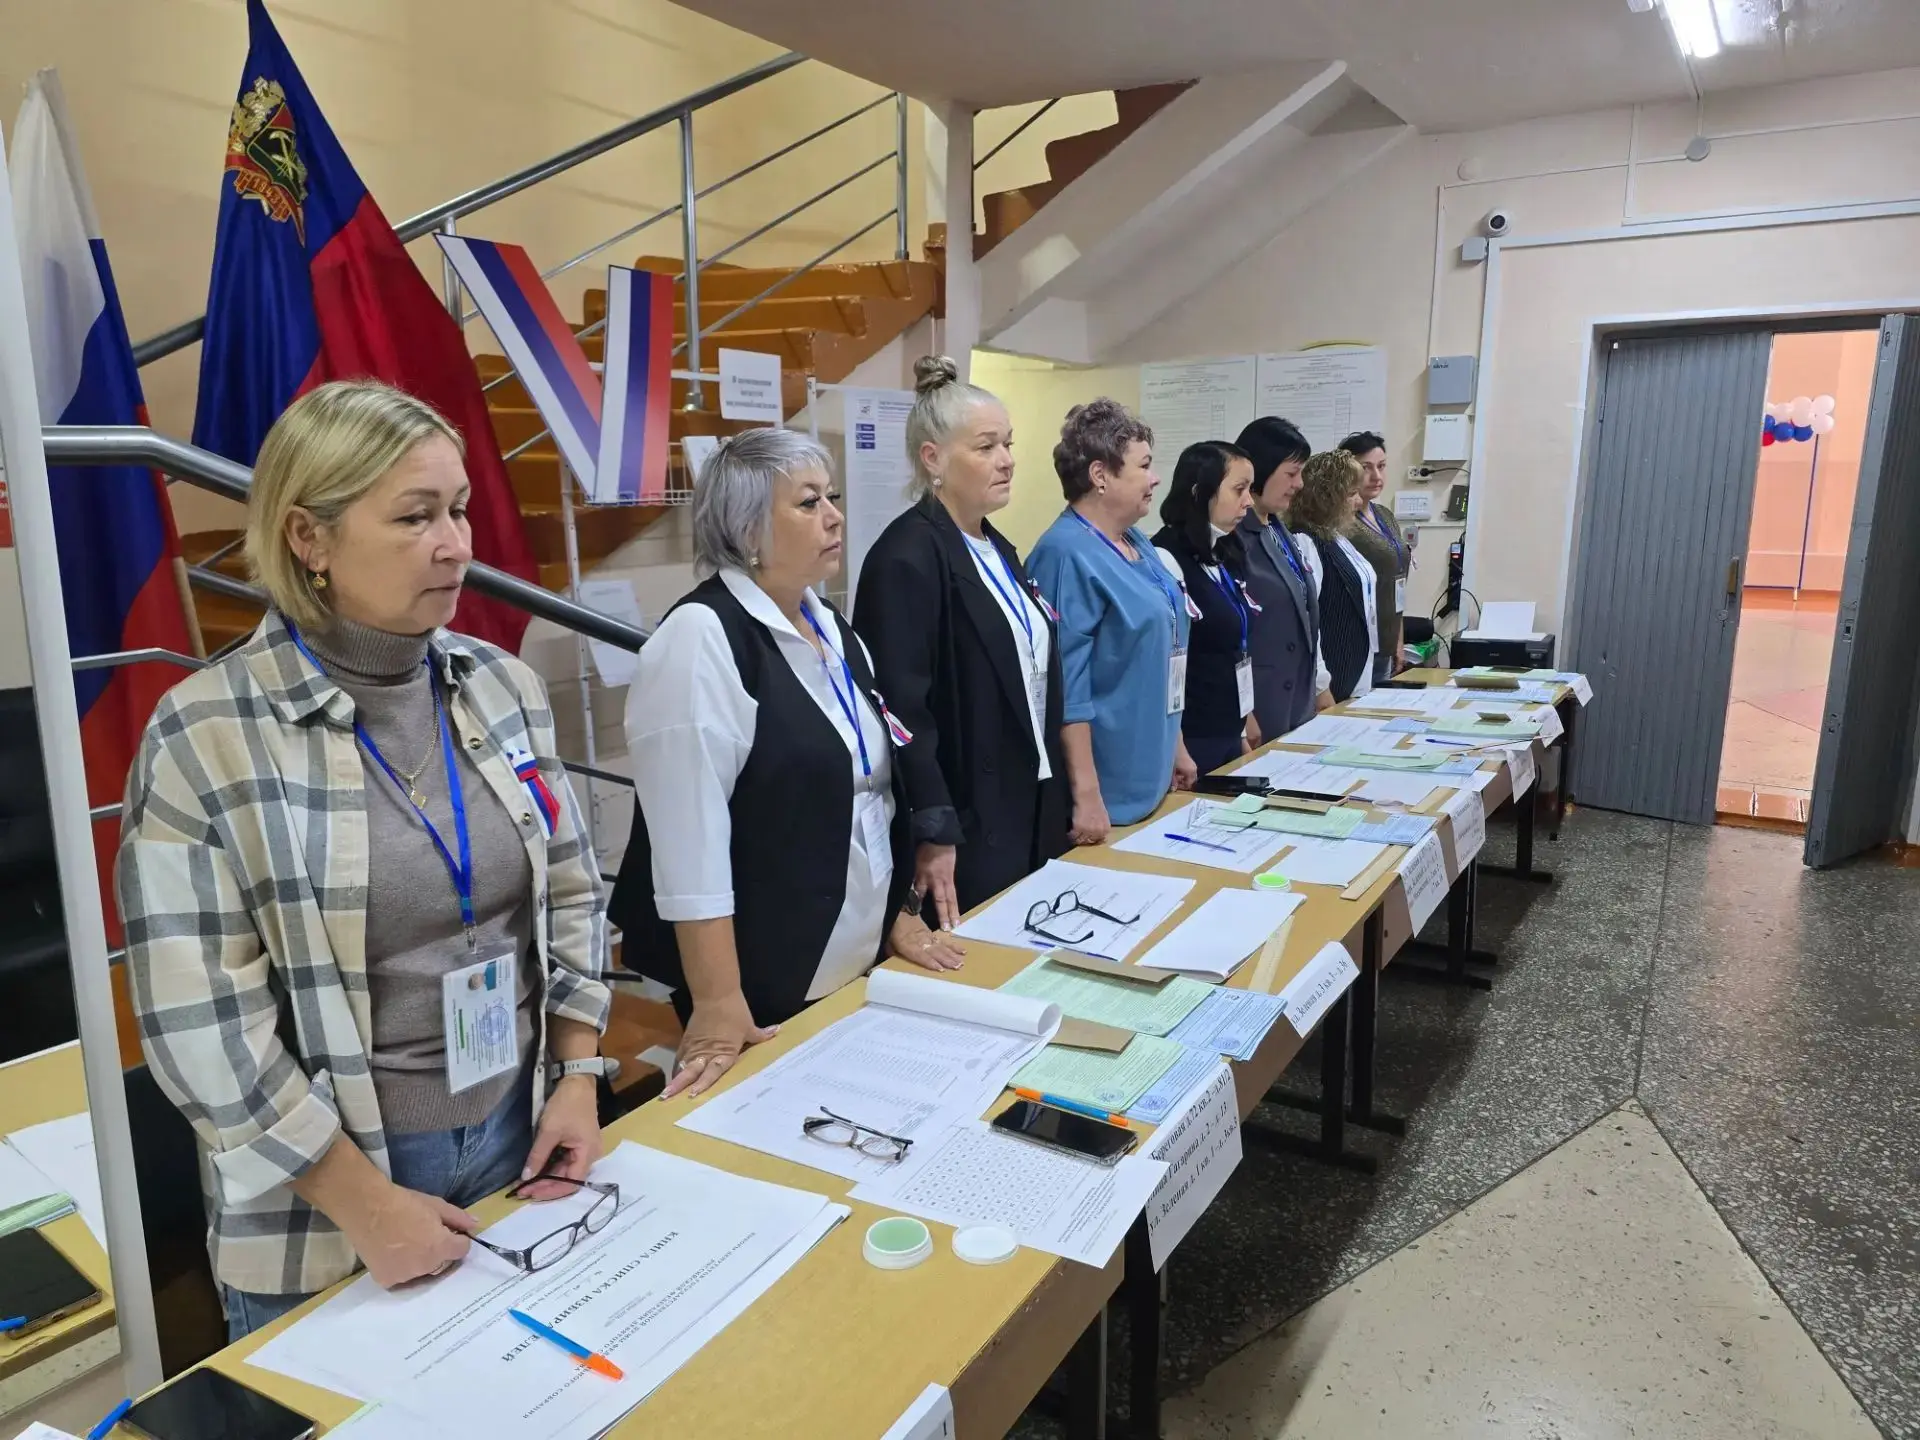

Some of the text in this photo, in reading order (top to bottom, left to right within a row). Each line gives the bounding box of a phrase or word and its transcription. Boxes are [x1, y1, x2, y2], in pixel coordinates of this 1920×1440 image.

[1162, 1179, 1188, 1216] Зеленая
[637, 1230, 680, 1259] КНИГА
[589, 1258, 643, 1295] СПИСКА
[498, 1294, 594, 1362] ИЗБИРАЕЛЕЙ
[520, 1387, 565, 1419] СОБРАНИЯ
